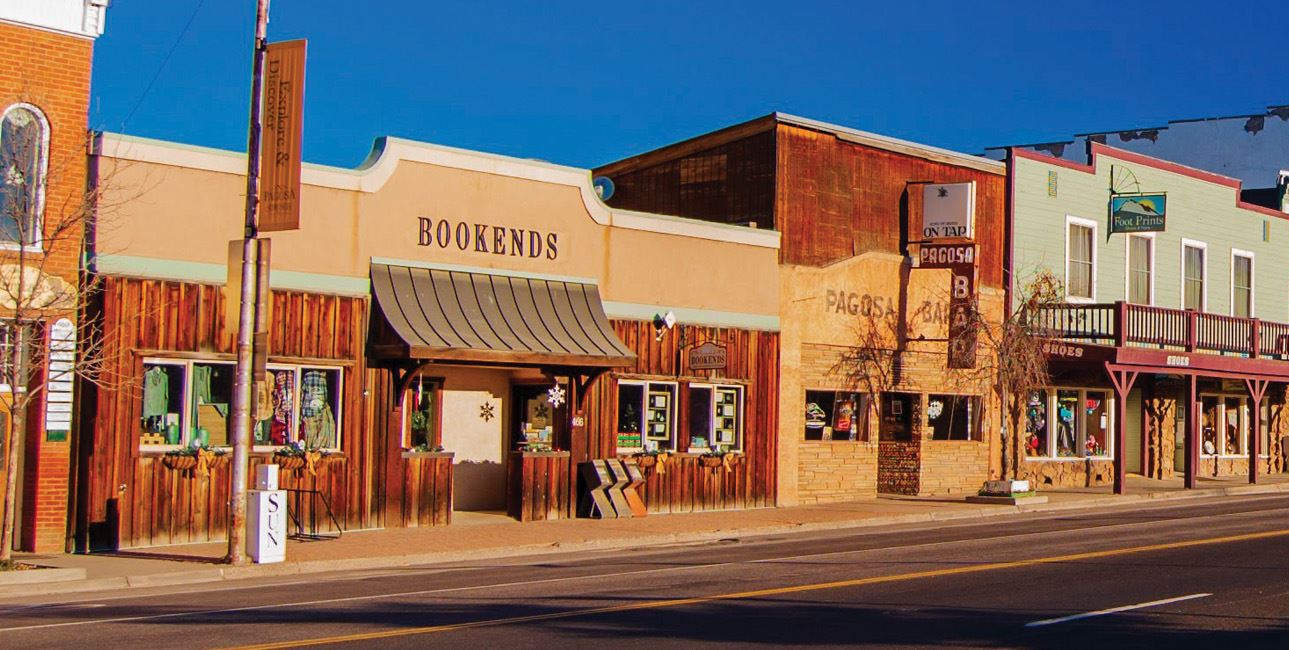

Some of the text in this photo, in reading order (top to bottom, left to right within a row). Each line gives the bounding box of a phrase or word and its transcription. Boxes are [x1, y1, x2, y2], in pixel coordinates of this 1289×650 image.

[266, 59, 280, 131] Discover
[276, 80, 290, 168] Explore &
[923, 225, 967, 238] ON TAP
[1114, 215, 1164, 226] Foot Prints
[417, 216, 558, 261] BOOKENDS
[920, 246, 974, 264] PAGOSA
[825, 289, 897, 320] PAGOSA
[1042, 343, 1084, 358] SHOES
[267, 492, 279, 548] SUN
